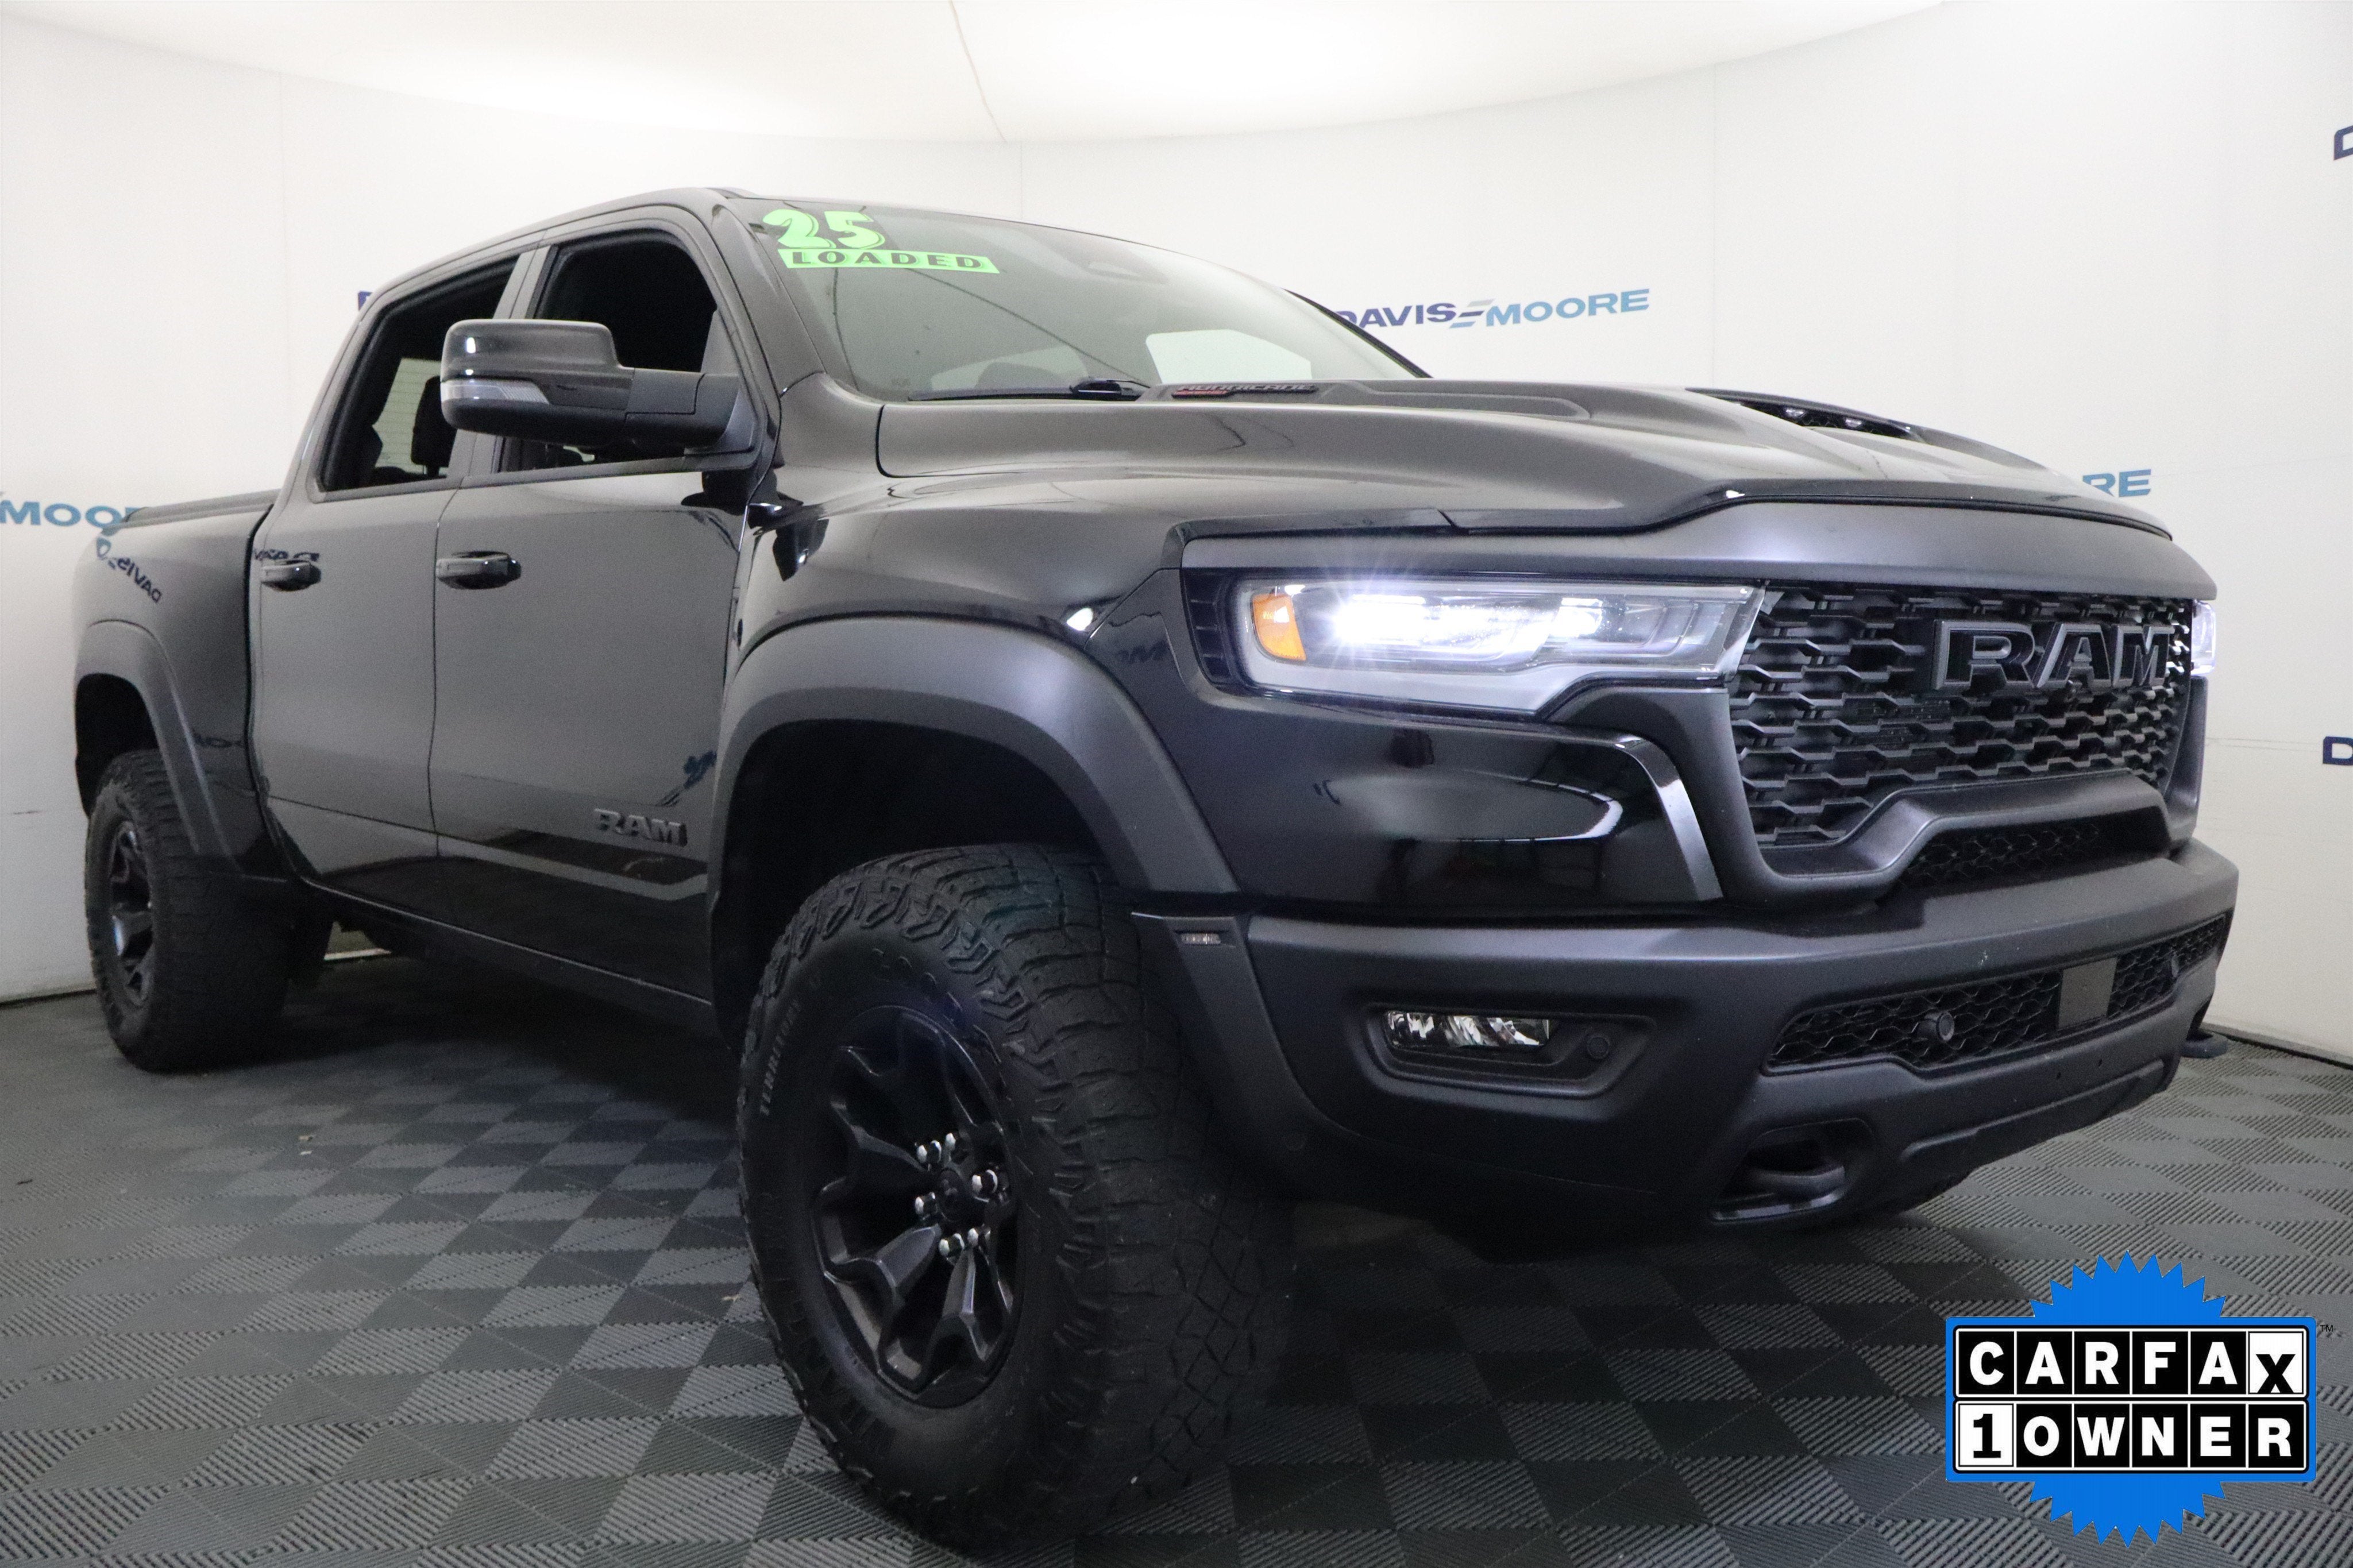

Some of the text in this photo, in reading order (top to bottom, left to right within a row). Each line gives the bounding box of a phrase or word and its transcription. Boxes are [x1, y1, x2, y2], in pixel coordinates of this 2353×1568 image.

[763, 208, 885, 249] 25
[792, 252, 984, 268] LOADED
[1486, 289, 1649, 327] MOORE
[0, 499, 142, 528] MOO
[1933, 619, 2175, 689] RAM
[594, 808, 688, 848] RAM
